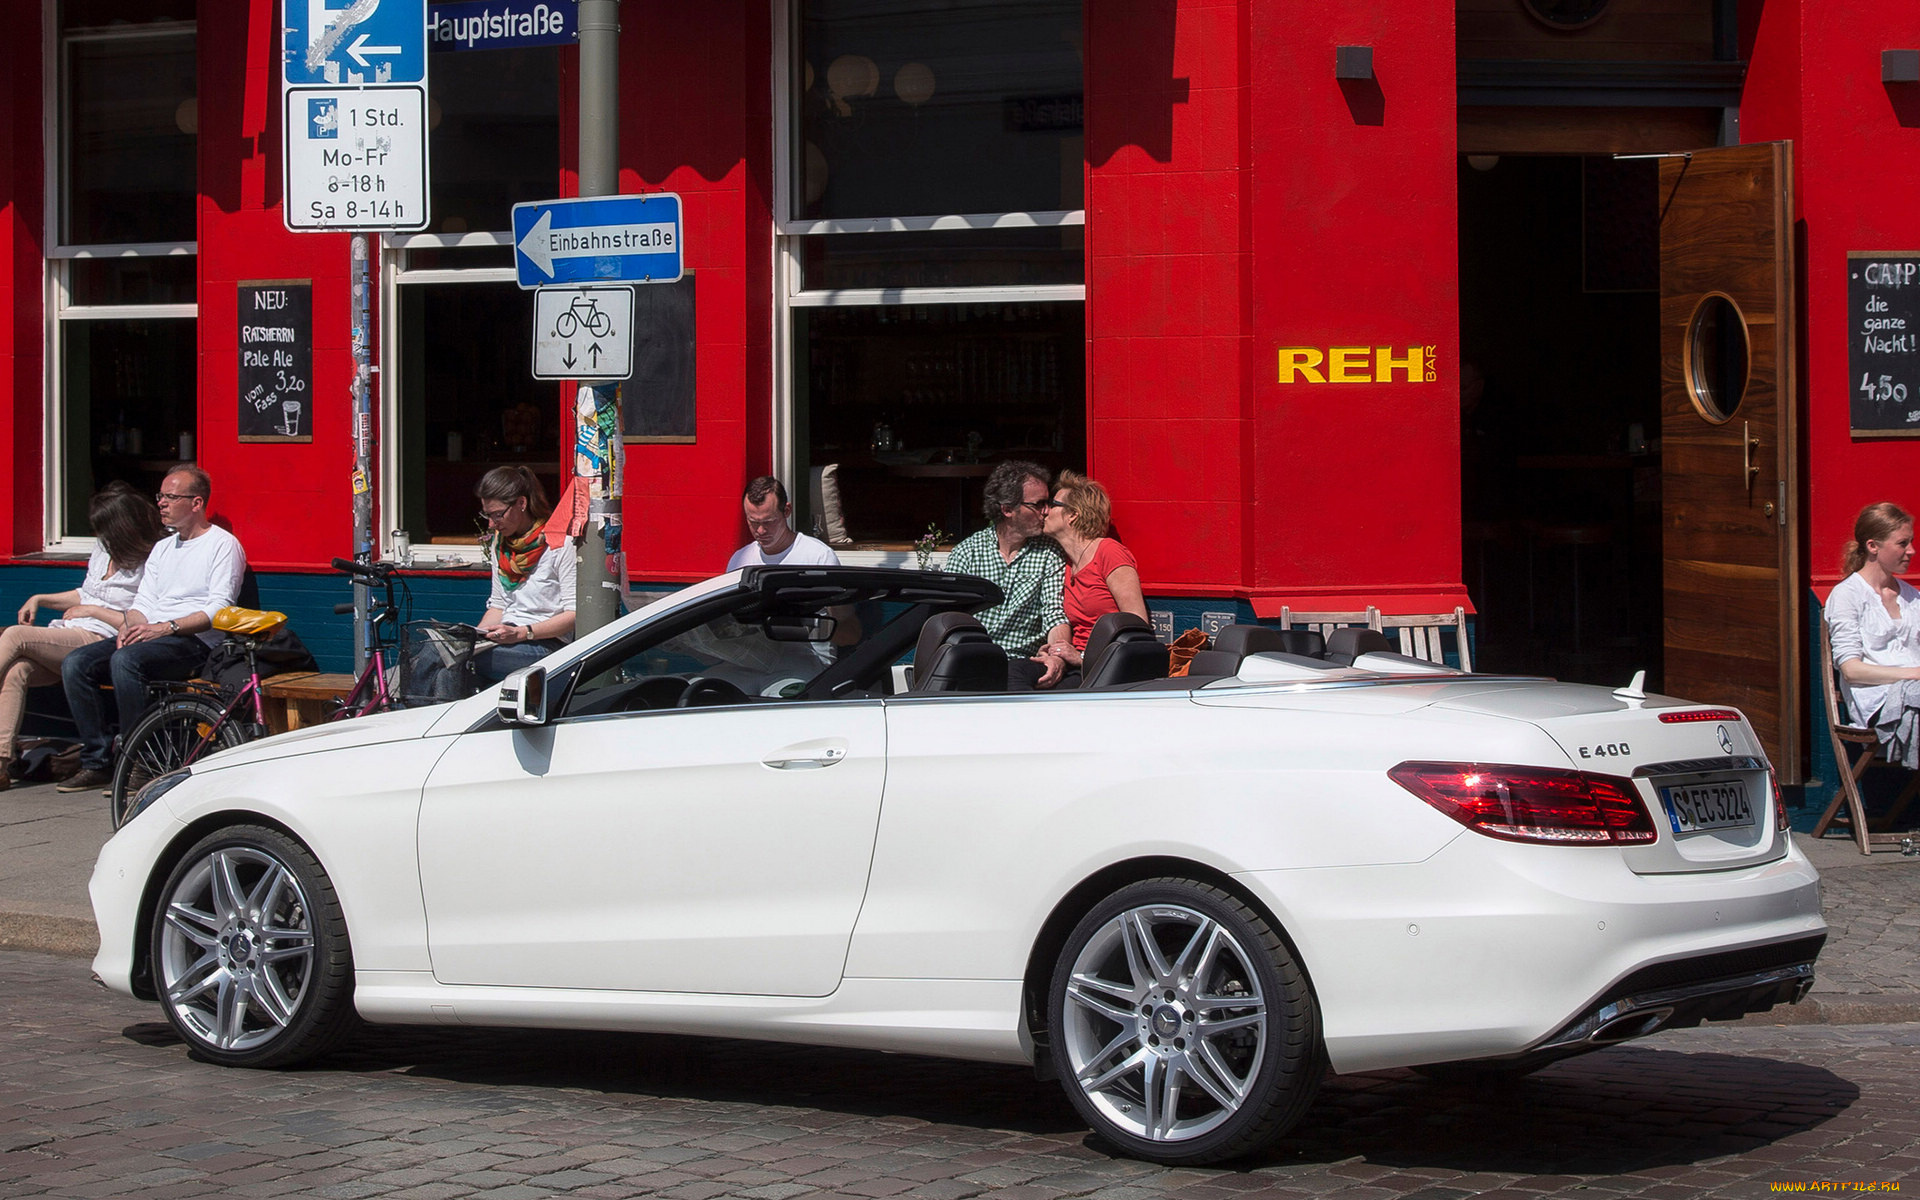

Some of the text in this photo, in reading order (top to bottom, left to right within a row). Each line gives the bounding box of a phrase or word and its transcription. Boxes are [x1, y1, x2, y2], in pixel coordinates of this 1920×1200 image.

[427, 4, 563, 48] Hauptstraße
[350, 108, 404, 126] 1 Std.
[323, 148, 387, 166] Mo-Fr
[311, 201, 335, 218] Sa
[550, 228, 673, 252] Einbahnstraße
[1865, 263, 1920, 285] CAIP
[254, 291, 288, 310] NEU:
[1865, 295, 1889, 312] die
[1860, 318, 1906, 336] ganze
[243, 350, 293, 367] Pale Ale
[1278, 346, 1424, 384] REH
[1425, 344, 1437, 382] BAR
[275, 370, 305, 393] 3,20
[1860, 372, 1908, 402] 4,50
[245, 384, 264, 404] vom
[255, 392, 278, 413] Fass
[1159, 623, 1172, 632] 150
[1210, 620, 1219, 632] S
[1578, 742, 1631, 759] E 400
[1715, 787, 1750, 821] 3224
